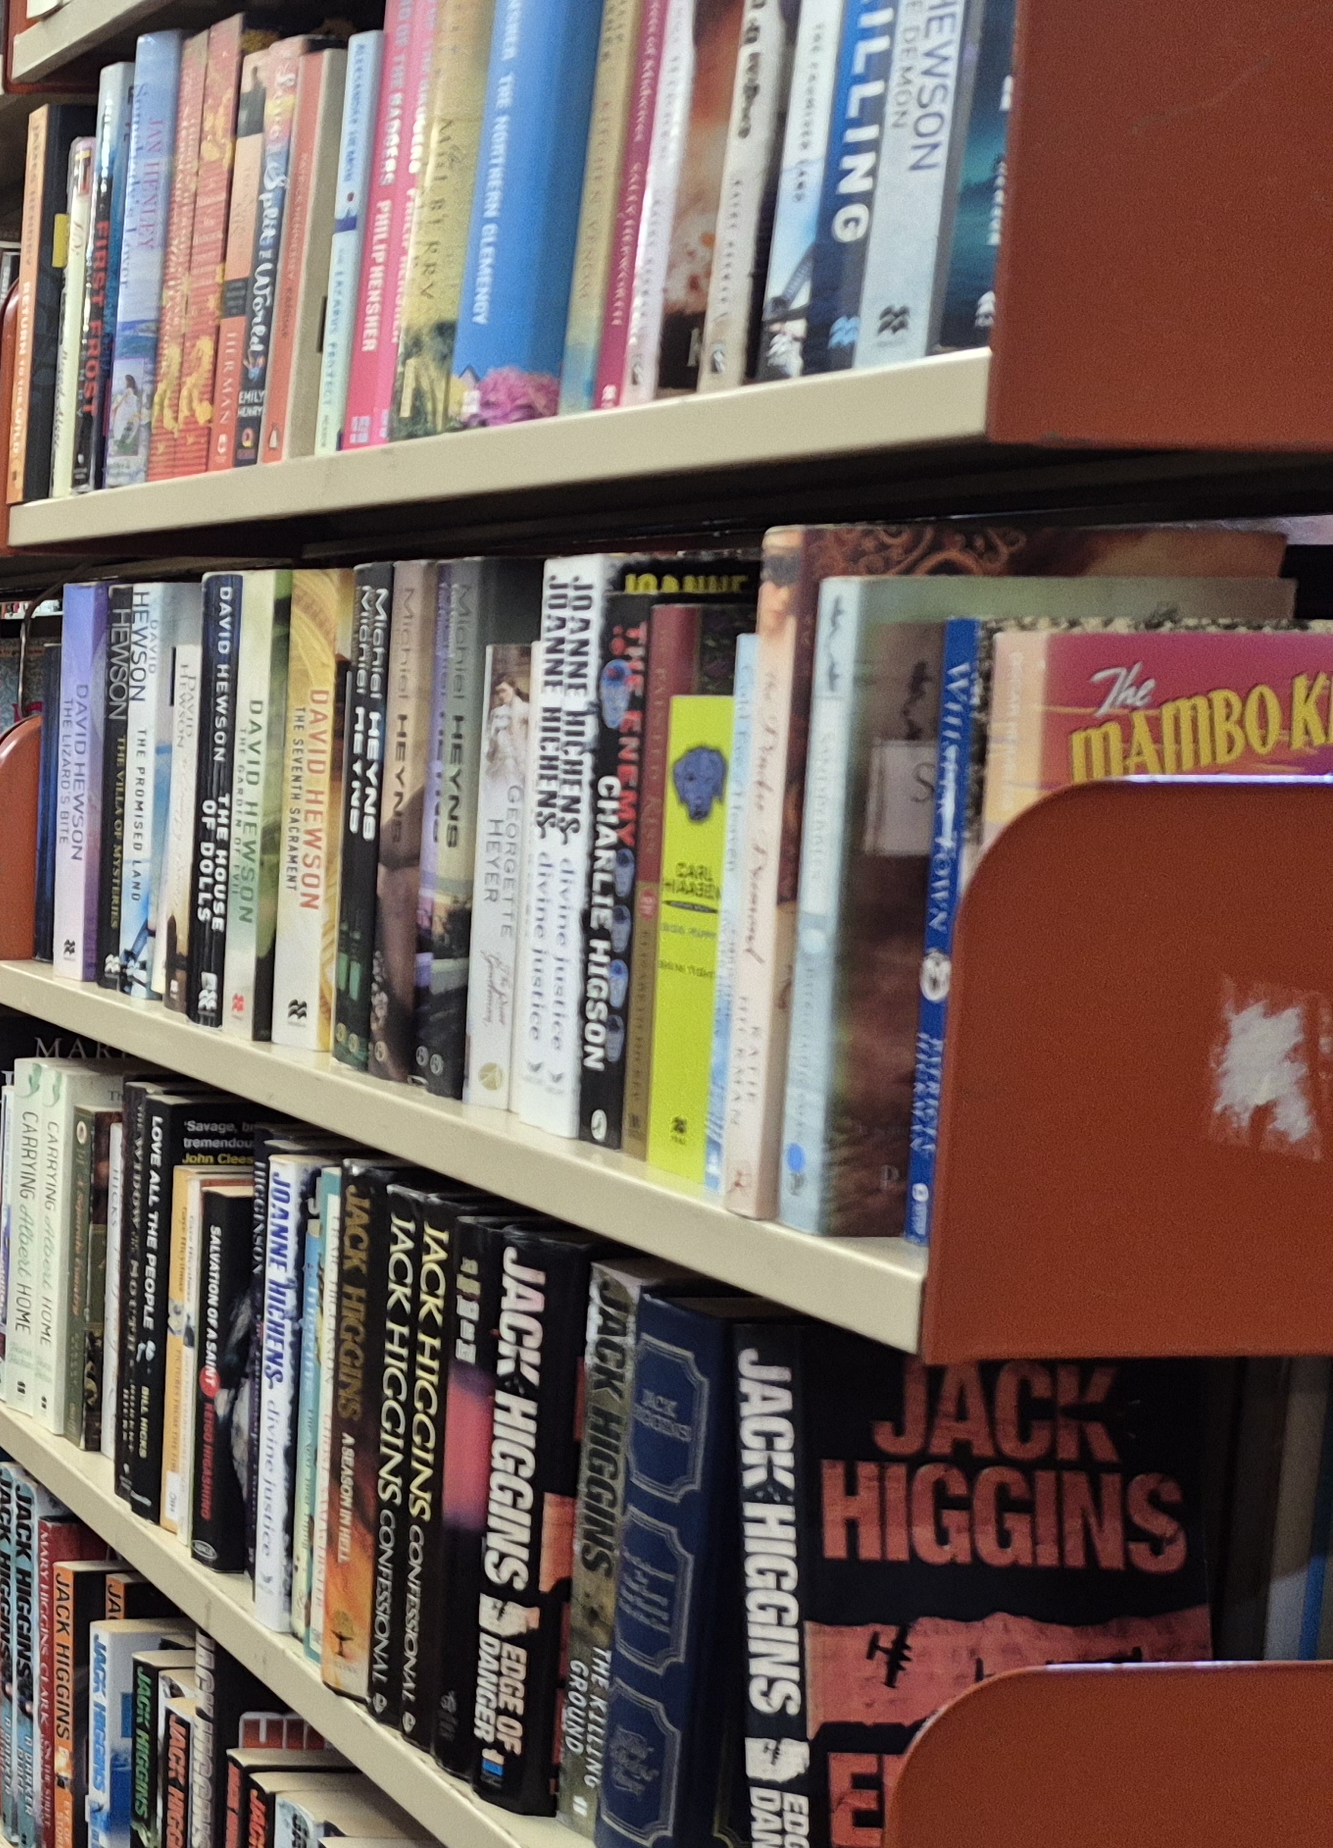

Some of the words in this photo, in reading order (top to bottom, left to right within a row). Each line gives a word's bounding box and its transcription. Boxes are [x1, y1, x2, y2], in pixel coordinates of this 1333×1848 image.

[496, 70, 515, 109] THE
[140, 162, 162, 249] HENLEY
[483, 114, 510, 218] NORTHERN
[92, 221, 109, 307] FIRST
[371, 199, 392, 263] PHILIP
[249, 264, 271, 351] World
[363, 265, 384, 352] HENSHER
[472, 223, 498, 325] CLEMENCY
[18, 282, 32, 354] RETURN
[82, 325, 101, 416] FROST
[218, 332, 238, 425] HERMAN
[239, 390, 266, 404] EMILY
[10, 407, 24, 453] WILD
[129, 592, 149, 702] HEWSON
[217, 586, 233, 654] DAVID
[543, 576, 569, 693] JOANNE
[564, 576, 595, 697] JOANNE
[108, 609, 130, 719] HEWSON
[1091, 663, 1157, 716] The
[62, 699, 74, 729] THE
[73, 684, 89, 757] DAVID
[115, 735, 127, 768] THE
[136, 730, 147, 757] THE
[214, 664, 230, 762] HEWSON
[245, 699, 264, 786] DAVID
[294, 707, 305, 734] THE
[308, 690, 330, 775] DAVID
[1071, 686, 1280, 783] MAMBO
[60, 734, 73, 805] LIZARD'S
[71, 762, 87, 861] HEWSON
[114, 774, 125, 817] VILLA
[133, 767, 146, 851] PROMISED
[291, 739, 303, 803] SEVENTH
[362, 711, 381, 841] HEYNS
[389, 714, 410, 843] HEYNS
[445, 714, 465, 849] HEYNS
[536, 706, 564, 840] HICHENS
[616, 711, 640, 845] ENEMY
[59, 811, 71, 845] BITE
[113, 822, 124, 839] OF
[202, 800, 216, 828] OF
[217, 794, 230, 840] THE
[285, 808, 300, 891] SACRAMENT
[299, 789, 323, 910] HEWSON
[589, 776, 620, 926] CHARLIE
[130, 860, 144, 902] LAND
[197, 842, 215, 923] DOLLS
[211, 849, 228, 931] HOUSE
[238, 801, 258, 924] HEWSON
[482, 819, 504, 903] HEYER
[498, 783, 523, 938] GEORGETTE
[533, 852, 553, 936] divine
[554, 858, 576, 944] divine
[528, 945, 549, 1040] justice
[550, 953, 573, 1051] justice
[584, 939, 610, 1072] HIGSON
[18, 1111, 38, 1199] CARRYING
[44, 1121, 60, 1210] CARRYING
[148, 1116, 163, 1165] LOVE
[182, 1153, 214, 1166] John
[146, 1211, 160, 1249] THE
[148, 1171, 161, 1207] ALL
[268, 1172, 292, 1268] JOANNE
[346, 1184, 372, 1278] JACK
[142, 1254, 158, 1329] PEOPLE
[206, 1225, 222, 1293] SALVATION
[387, 1213, 417, 1311] JACK
[417, 1221, 450, 1328] JACK
[15, 1283, 32, 1335] HOME
[40, 1296, 53, 1345] HOME
[207, 1302, 218, 1320] OF
[495, 1245, 547, 1388] JACK
[584, 1274, 629, 1397] JACK
[203, 1334, 217, 1386] SAINT
[337, 1288, 369, 1420] HIGGINS
[138, 1417, 150, 1457] HICKS
[139, 1386, 150, 1414] BILL
[202, 1403, 214, 1442] KEIGO
[262, 1399, 280, 1469] divine
[341, 1432, 356, 1445] A
[377, 1321, 409, 1504] HIGGINS
[406, 1341, 443, 1522] HIGGINS
[737, 1347, 796, 1490] JACK
[871, 1360, 1122, 1461] JACK
[0, 1470, 13, 1540] JACK
[199, 1445, 213, 1520] HIGASHINO
[258, 1477, 279, 1558] justice
[338, 1510, 352, 1527] IN
[339, 1449, 355, 1508] SEASON
[484, 1389, 538, 1592] HIGGINS
[581, 1405, 624, 1578] HIGGINS
[820, 1460, 1190, 1574] HIGGINS
[15, 1486, 33, 1559] JACK
[40, 1530, 50, 1573] MARY
[335, 1530, 352, 1564] HELL
[0, 1557, 11, 1666] HIGGINS
[15, 1568, 33, 1678] HIGGINS
[40, 1580, 50, 1657] HIGGINS
[56, 1573, 72, 1634] JACK
[373, 1509, 398, 1684] CONFESSIONAL
[401, 1523, 424, 1708] CONFESSIONAL
[742, 1500, 800, 1717] HIGGINS
[40, 1663, 50, 1724] CLARK
[56, 1641, 71, 1741] HIGGINS
[94, 1634, 107, 1697] JACK
[136, 1667, 151, 1727] JACK
[474, 1634, 500, 1742] DANGER
[504, 1646, 529, 1714] EDGE
[562, 1659, 591, 1755] GROUND
[589, 1648, 611, 1688] THE
[92, 1701, 106, 1794] HIGGINS
[134, 1731, 149, 1820] HIGGINS
[169, 1715, 188, 1780] JACK
[499, 1717, 525, 1756] OF
[584, 1690, 608, 1788] KILLING
